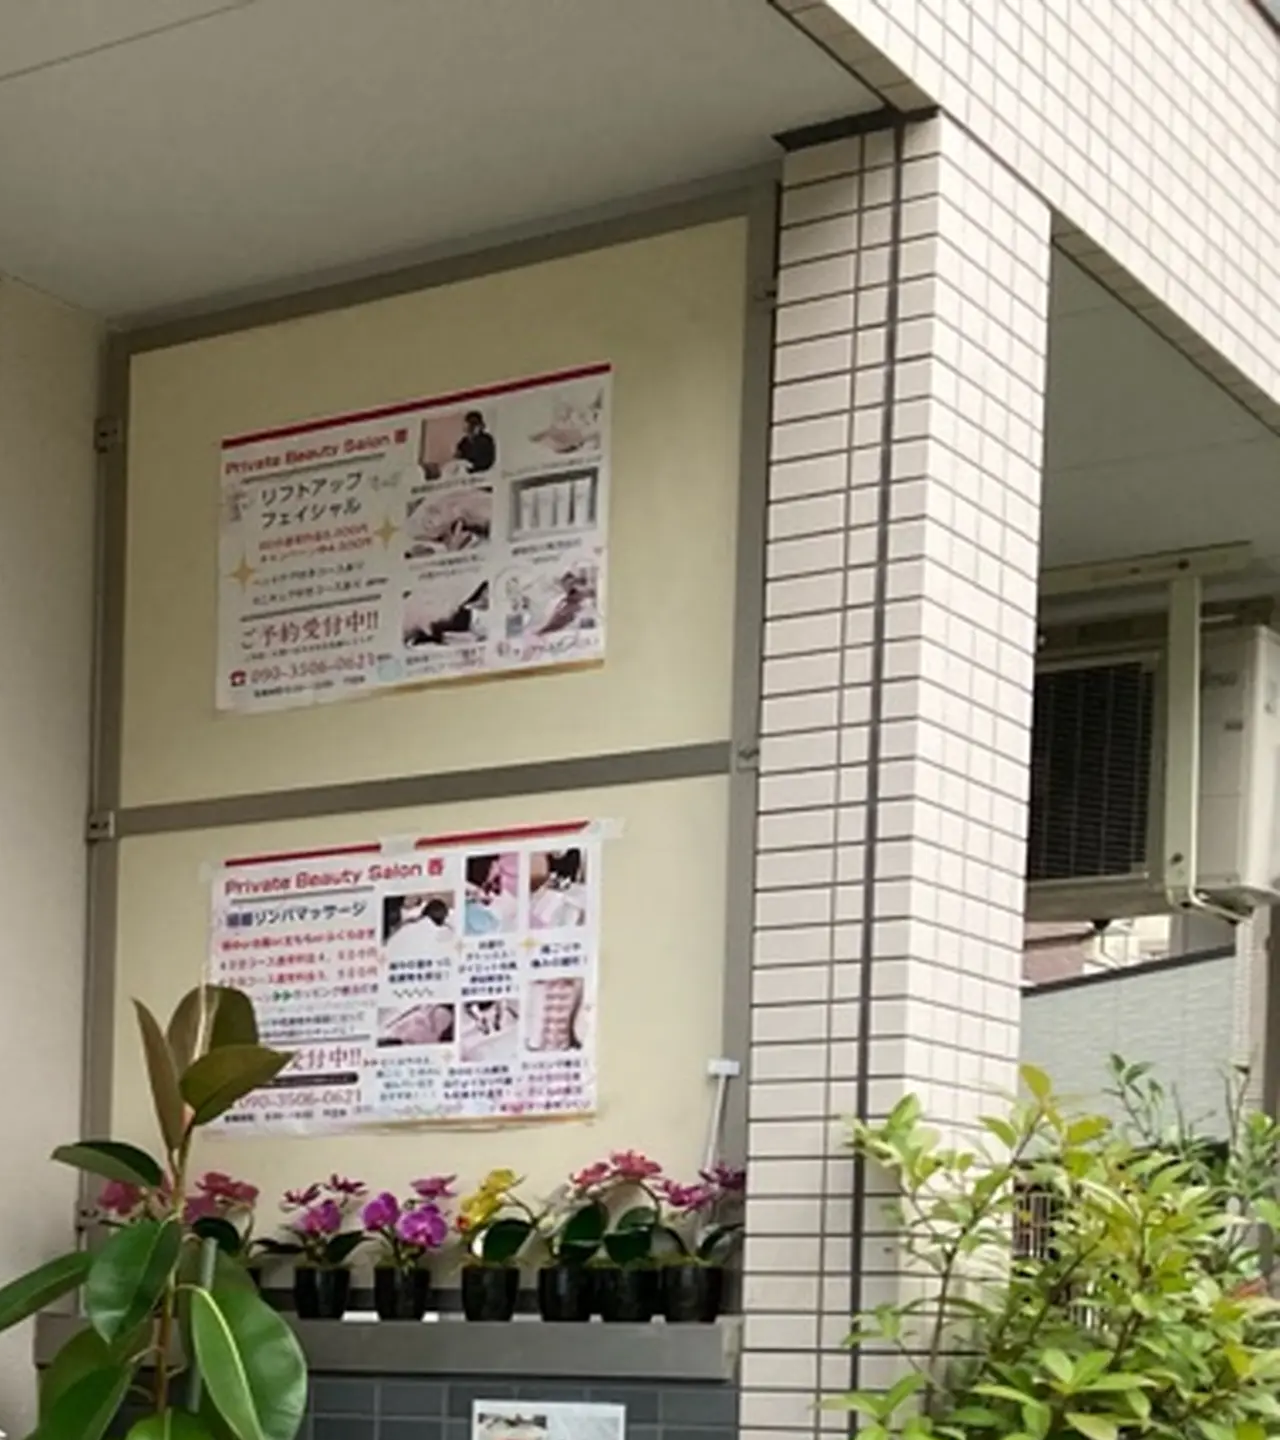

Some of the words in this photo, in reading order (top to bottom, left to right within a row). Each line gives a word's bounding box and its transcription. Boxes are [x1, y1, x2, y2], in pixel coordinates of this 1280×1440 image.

[343, 434, 391, 452] Salon
[262, 471, 362, 506] リフトアップ
[261, 496, 362, 529] フェイシャル
[225, 876, 291, 895] Private
[296, 869, 361, 889] Beauty
[368, 863, 423, 881] Salon
